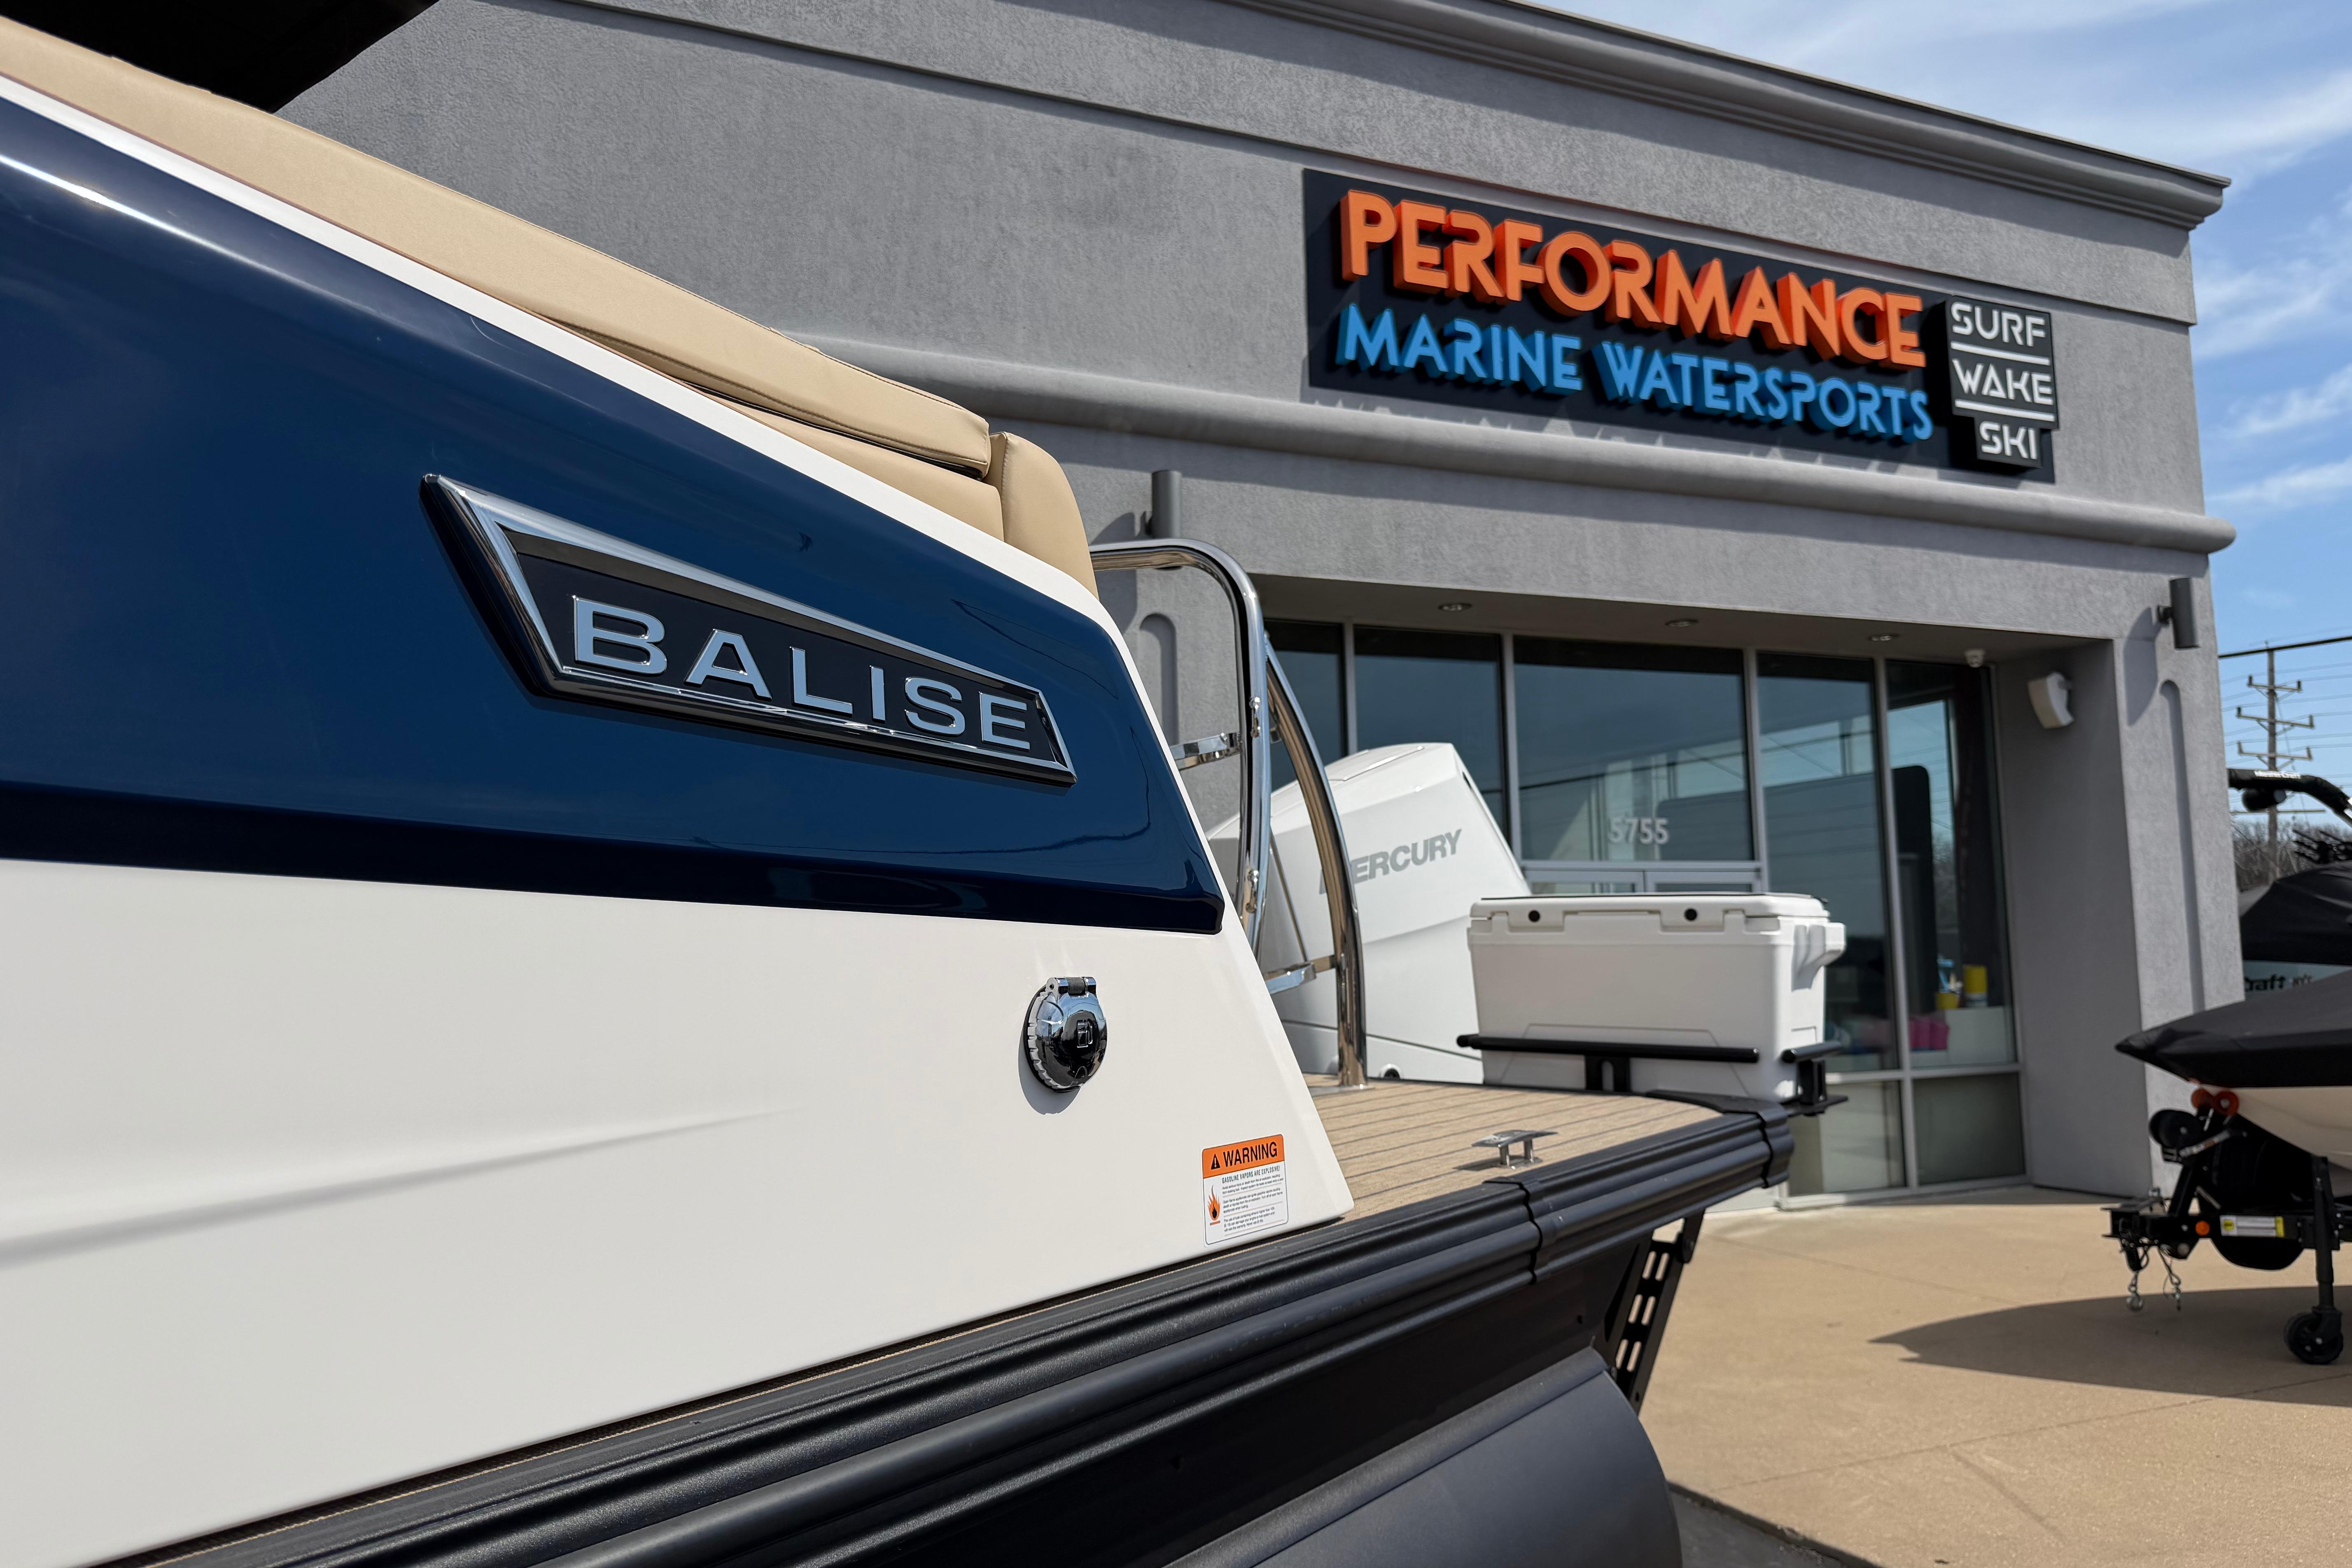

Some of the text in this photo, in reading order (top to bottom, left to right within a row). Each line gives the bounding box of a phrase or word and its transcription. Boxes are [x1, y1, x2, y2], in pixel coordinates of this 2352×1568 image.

[1341, 189, 1927, 370] PERFORMANCE
[1951, 301, 2046, 347] SURF
[1337, 303, 1934, 441] MARINE WATERSPORTS
[1952, 357, 2054, 406] WAKE
[1979, 420, 2038, 460] SKI
[572, 594, 1032, 752] BALISE
[1608, 817, 1669, 845] 5755
[1223, 1141, 1277, 1167] WARNING
[1222, 1174, 1239, 1184] GASOLINE
[1240, 1171, 1253, 1180] VAPORS
